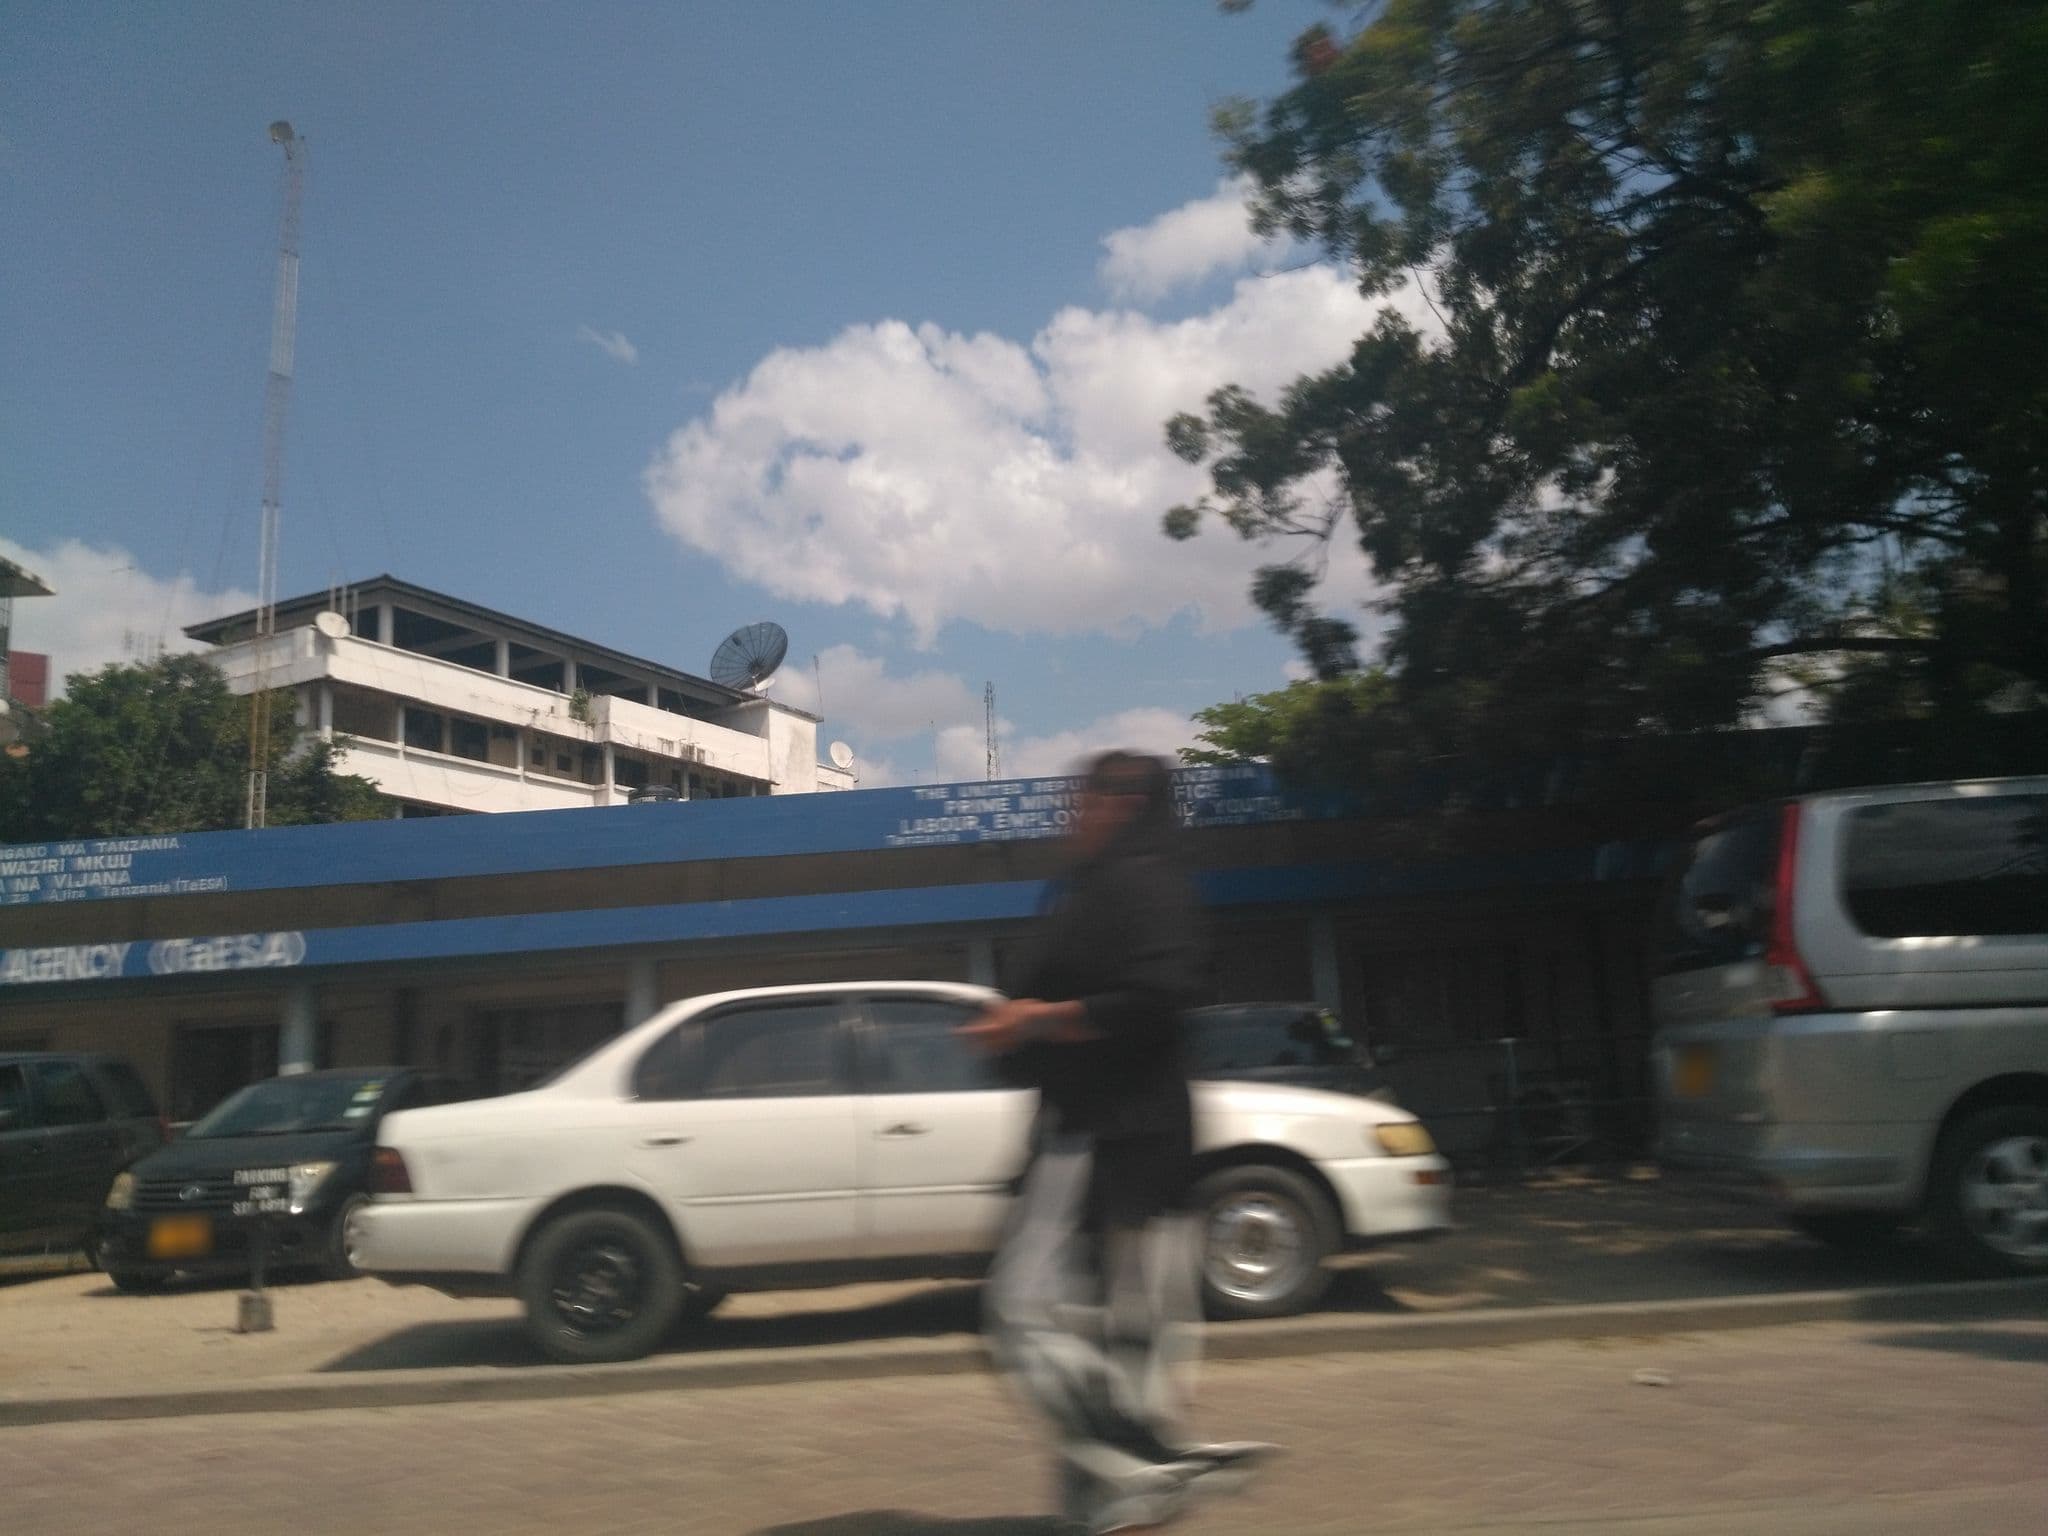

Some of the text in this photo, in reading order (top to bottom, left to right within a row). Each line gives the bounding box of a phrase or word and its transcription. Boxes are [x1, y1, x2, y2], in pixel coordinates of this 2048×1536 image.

[60, 844, 86, 855] WA
[95, 837, 179, 853] TANZANIA
[76, 854, 132, 871] MKUU
[15, 876, 40, 893] NA
